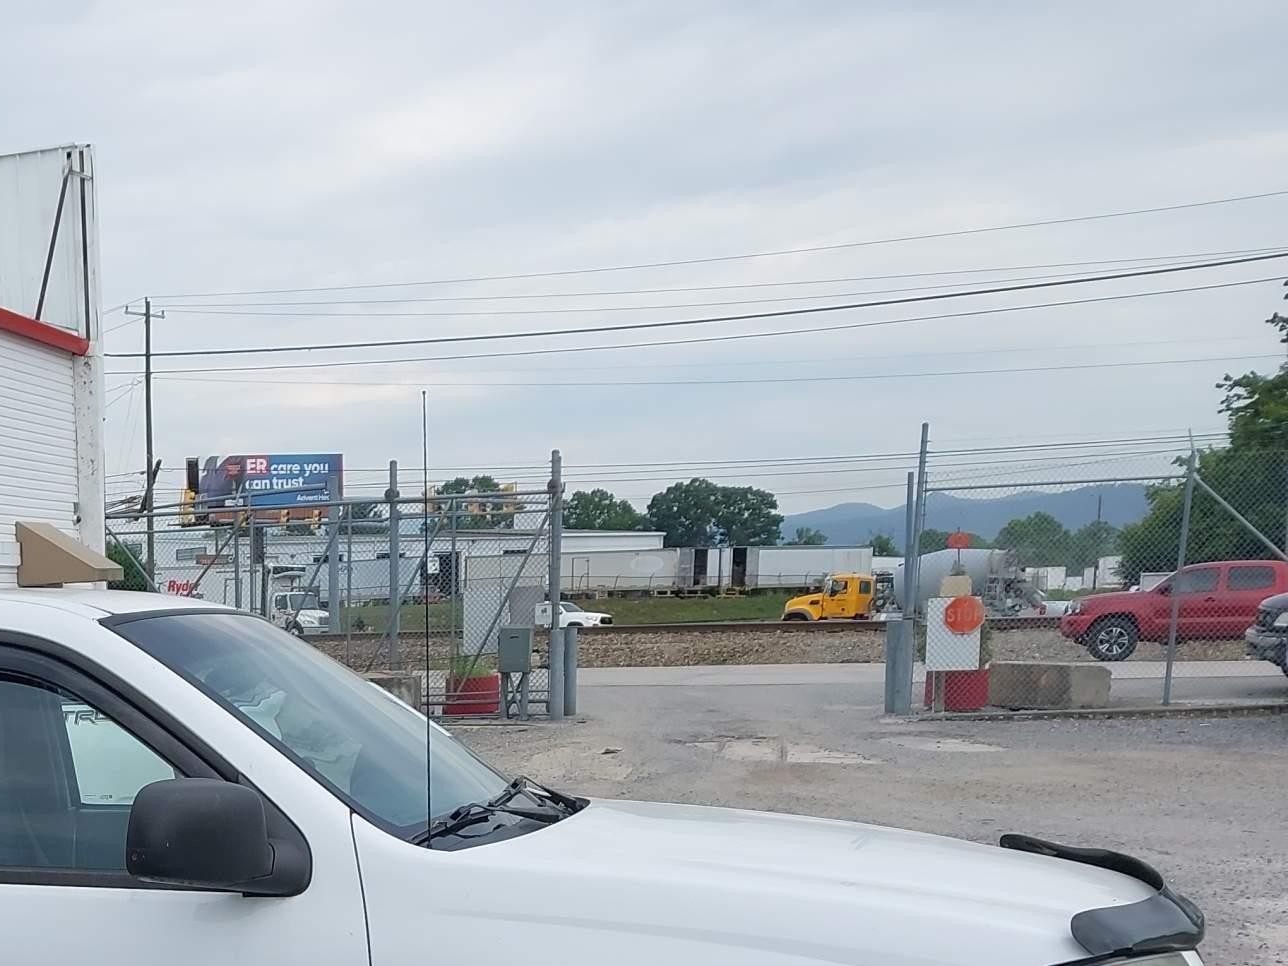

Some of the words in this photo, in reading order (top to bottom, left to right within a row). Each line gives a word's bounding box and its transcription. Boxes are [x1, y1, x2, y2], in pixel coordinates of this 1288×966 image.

[246, 458, 267, 474] ER
[271, 463, 301, 475] care
[304, 463, 329, 477] you
[245, 479, 271, 490] can
[272, 476, 305, 490] trust
[947, 608, 983, 622] STOP
